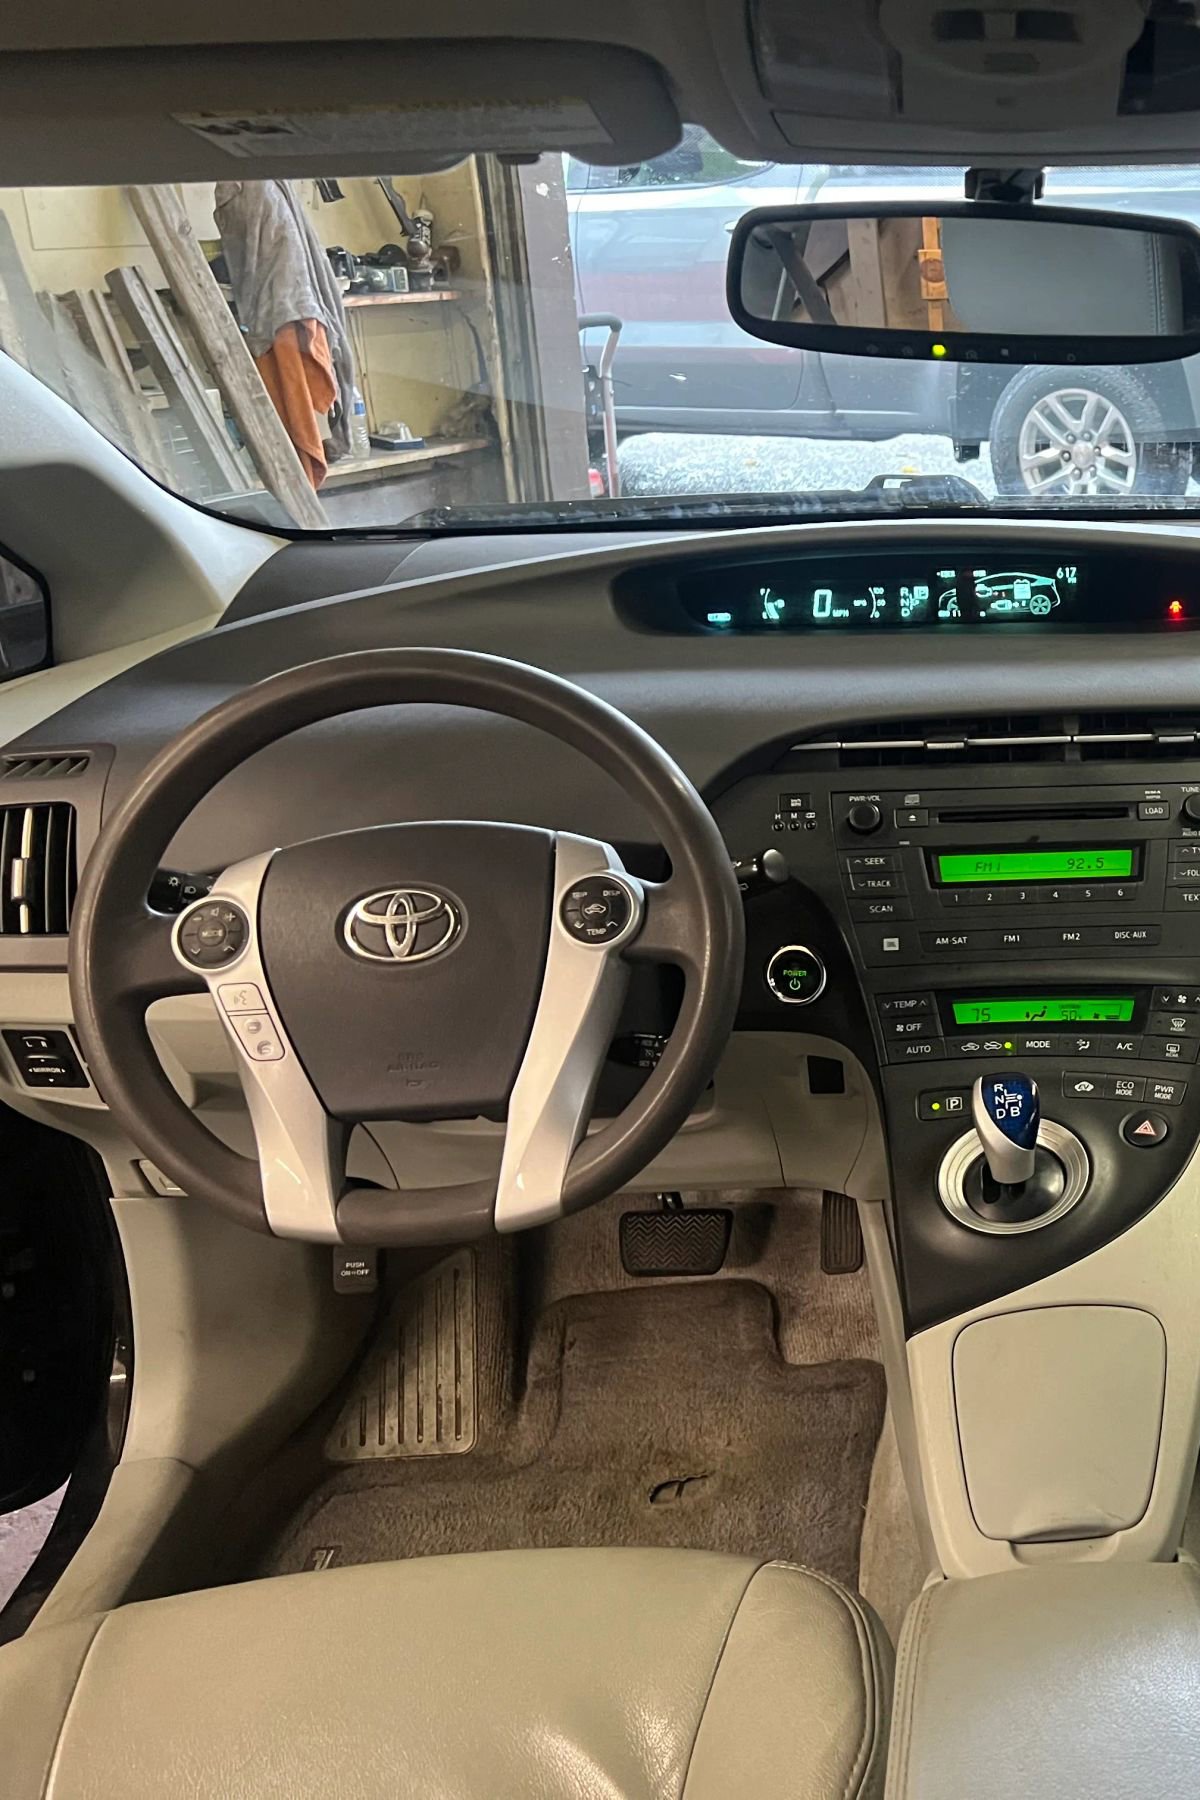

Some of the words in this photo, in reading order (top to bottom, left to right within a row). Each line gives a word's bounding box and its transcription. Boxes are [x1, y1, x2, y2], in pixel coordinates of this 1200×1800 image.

[813, 588, 833, 618] 0
[1144, 807, 1164, 815] LOAD
[864, 857, 886, 866] SEEK
[1067, 857, 1105, 871] 92.5
[867, 880, 891, 888] TRACK
[1020, 892, 1026, 900] 3
[1052, 890, 1059, 898] 4
[1085, 889, 1092, 898] 5
[1117, 888, 1124, 896] 6
[987, 893, 993, 901] 2
[869, 905, 894, 914] SCAN
[586, 928, 607, 936] TEMP
[782, 969, 808, 977] POWER
[893, 1000, 918, 1009] TEMP
[905, 1023, 923, 1032] OFF
[1025, 1040, 1051, 1049] MODE
[1116, 1042, 1134, 1051] A/C
[906, 1045, 932, 1054] AUTO
[993, 1083, 1004, 1093] R
[1116, 1080, 1135, 1090] ECO
[1154, 1084, 1175, 1094] PWR
[994, 1095, 1005, 1105] N
[1153, 1092, 1172, 1100] MODE
[995, 1108, 1006, 1120] D
[1010, 1106, 1021, 1117] B
